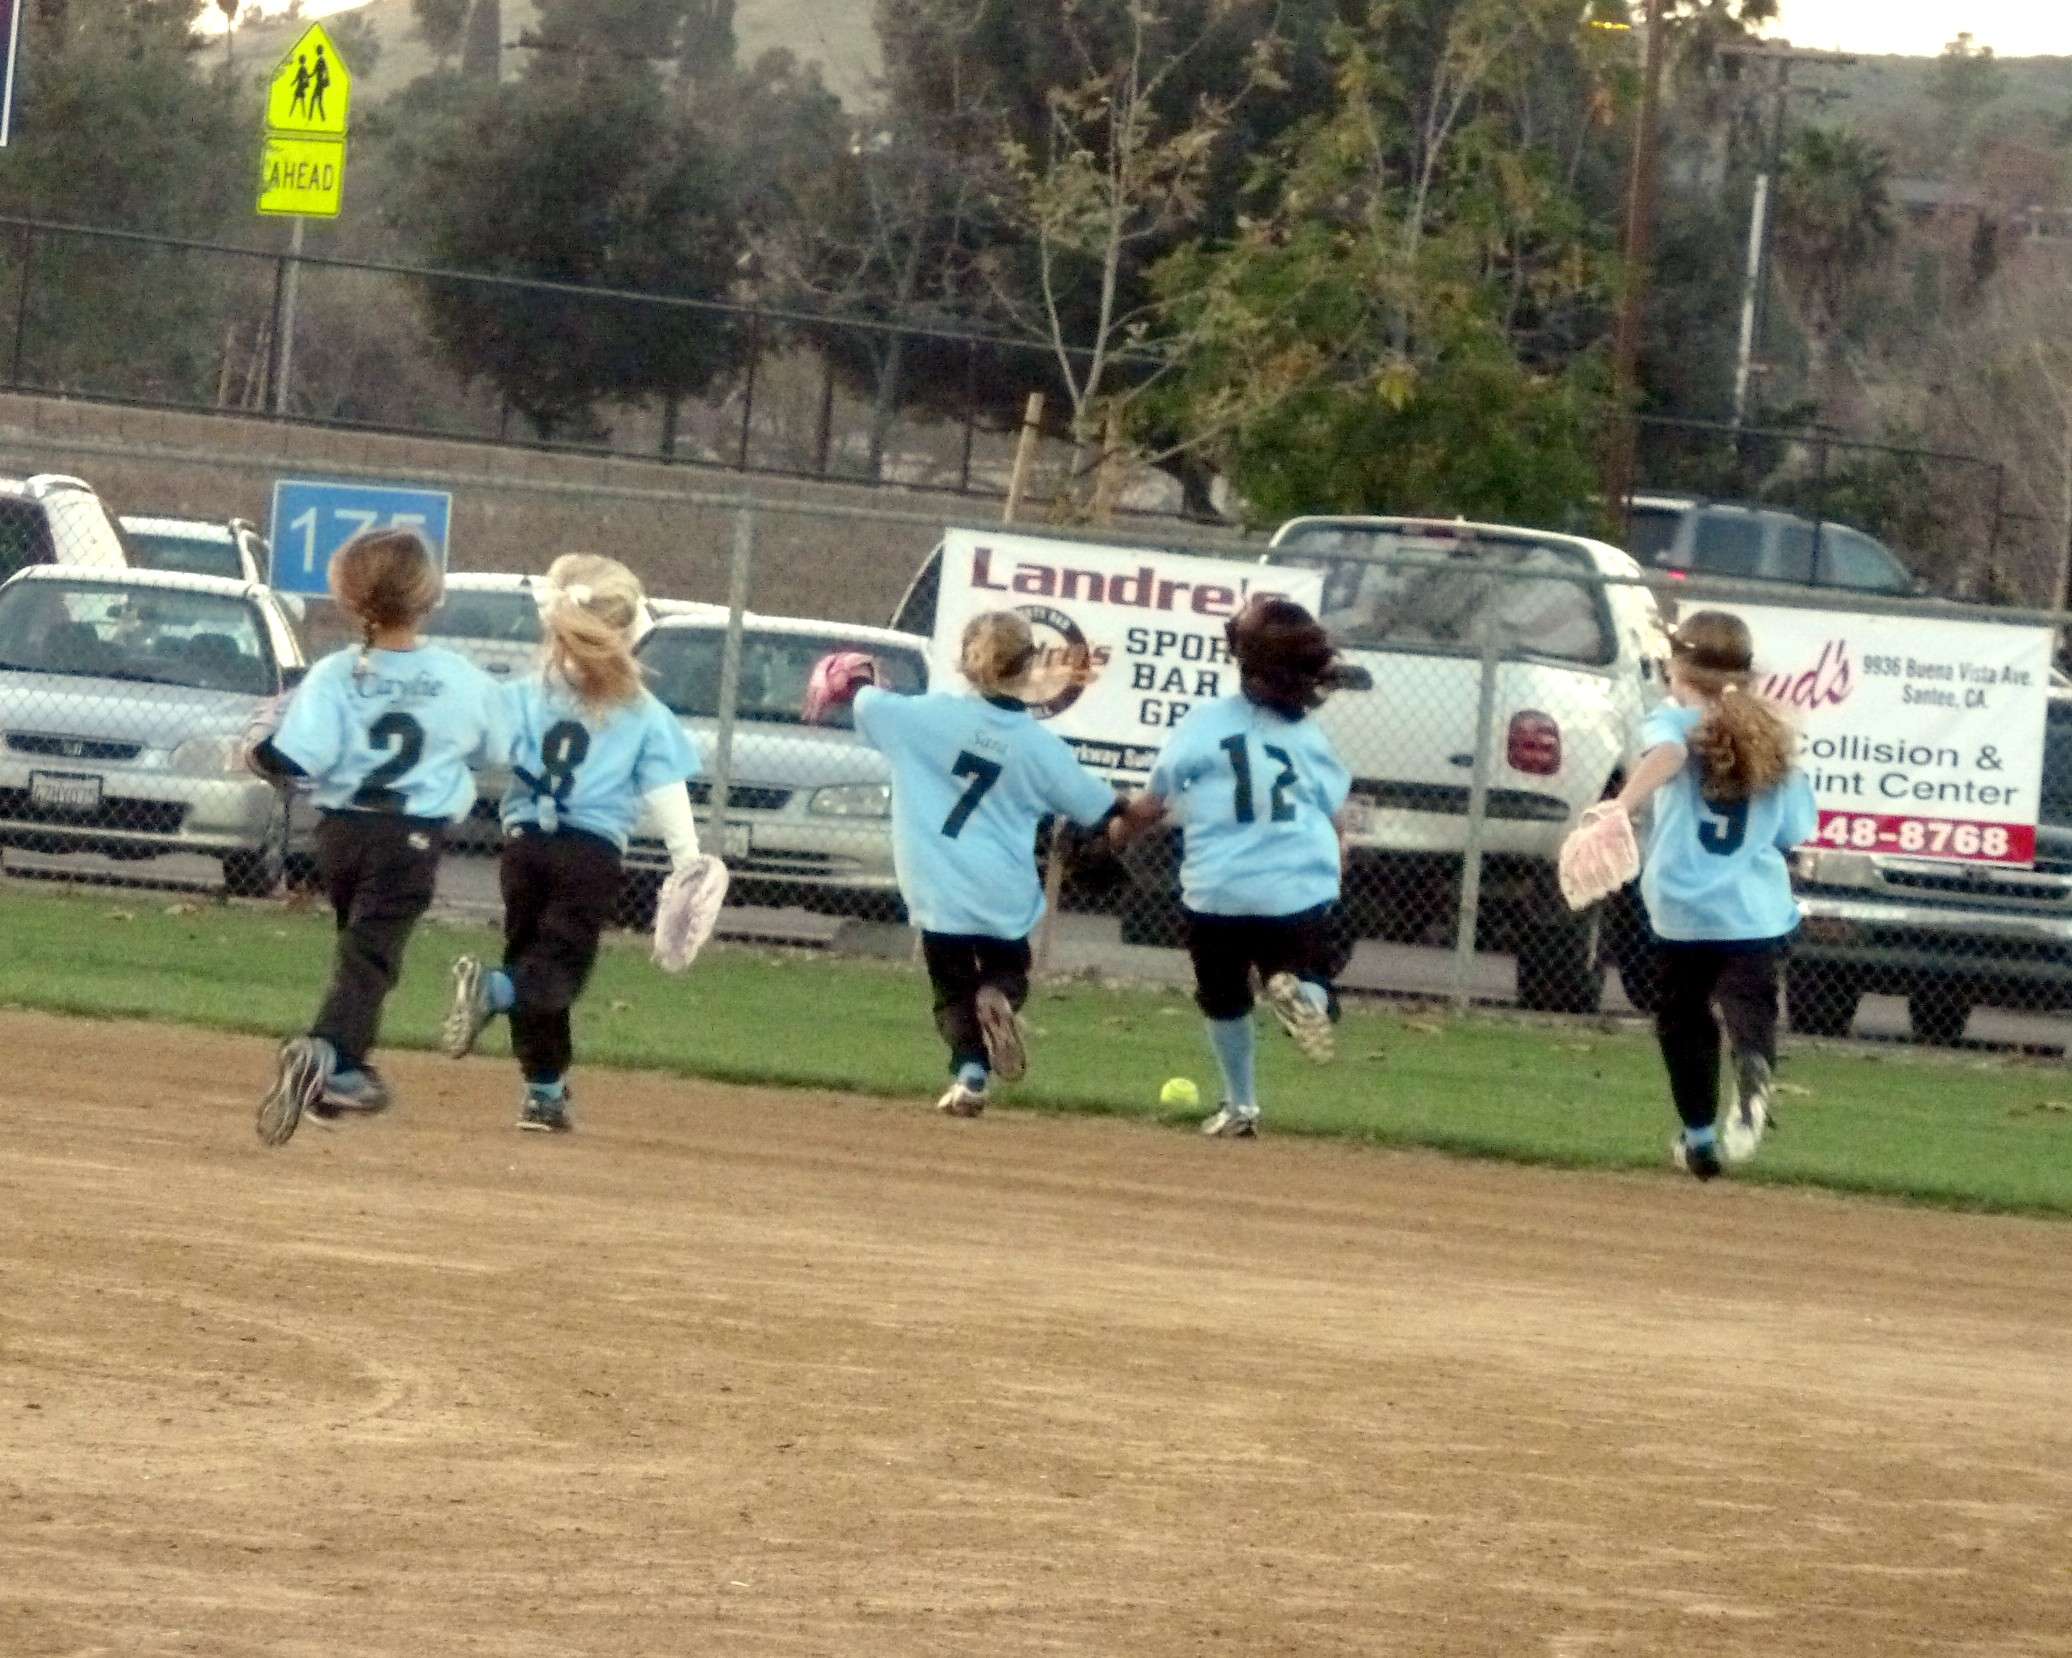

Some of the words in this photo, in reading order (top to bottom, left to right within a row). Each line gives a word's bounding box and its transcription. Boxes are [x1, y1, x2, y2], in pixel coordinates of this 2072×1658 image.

[269, 160, 334, 192] AHEAD
[1126, 627, 1232, 664] SPOR
[1131, 662, 1219, 697] BAR
[1906, 657, 1953, 681] Buena
[1959, 661, 1997, 685] Vista
[353, 711, 426, 811] 2
[1975, 744, 2004, 771] &
[941, 750, 1003, 839] 7
[1218, 732, 1299, 825] 12
[1812, 766, 1865, 796] int
[1878, 772, 2019, 805] Center
[1819, 814, 2010, 858] 48-8768
